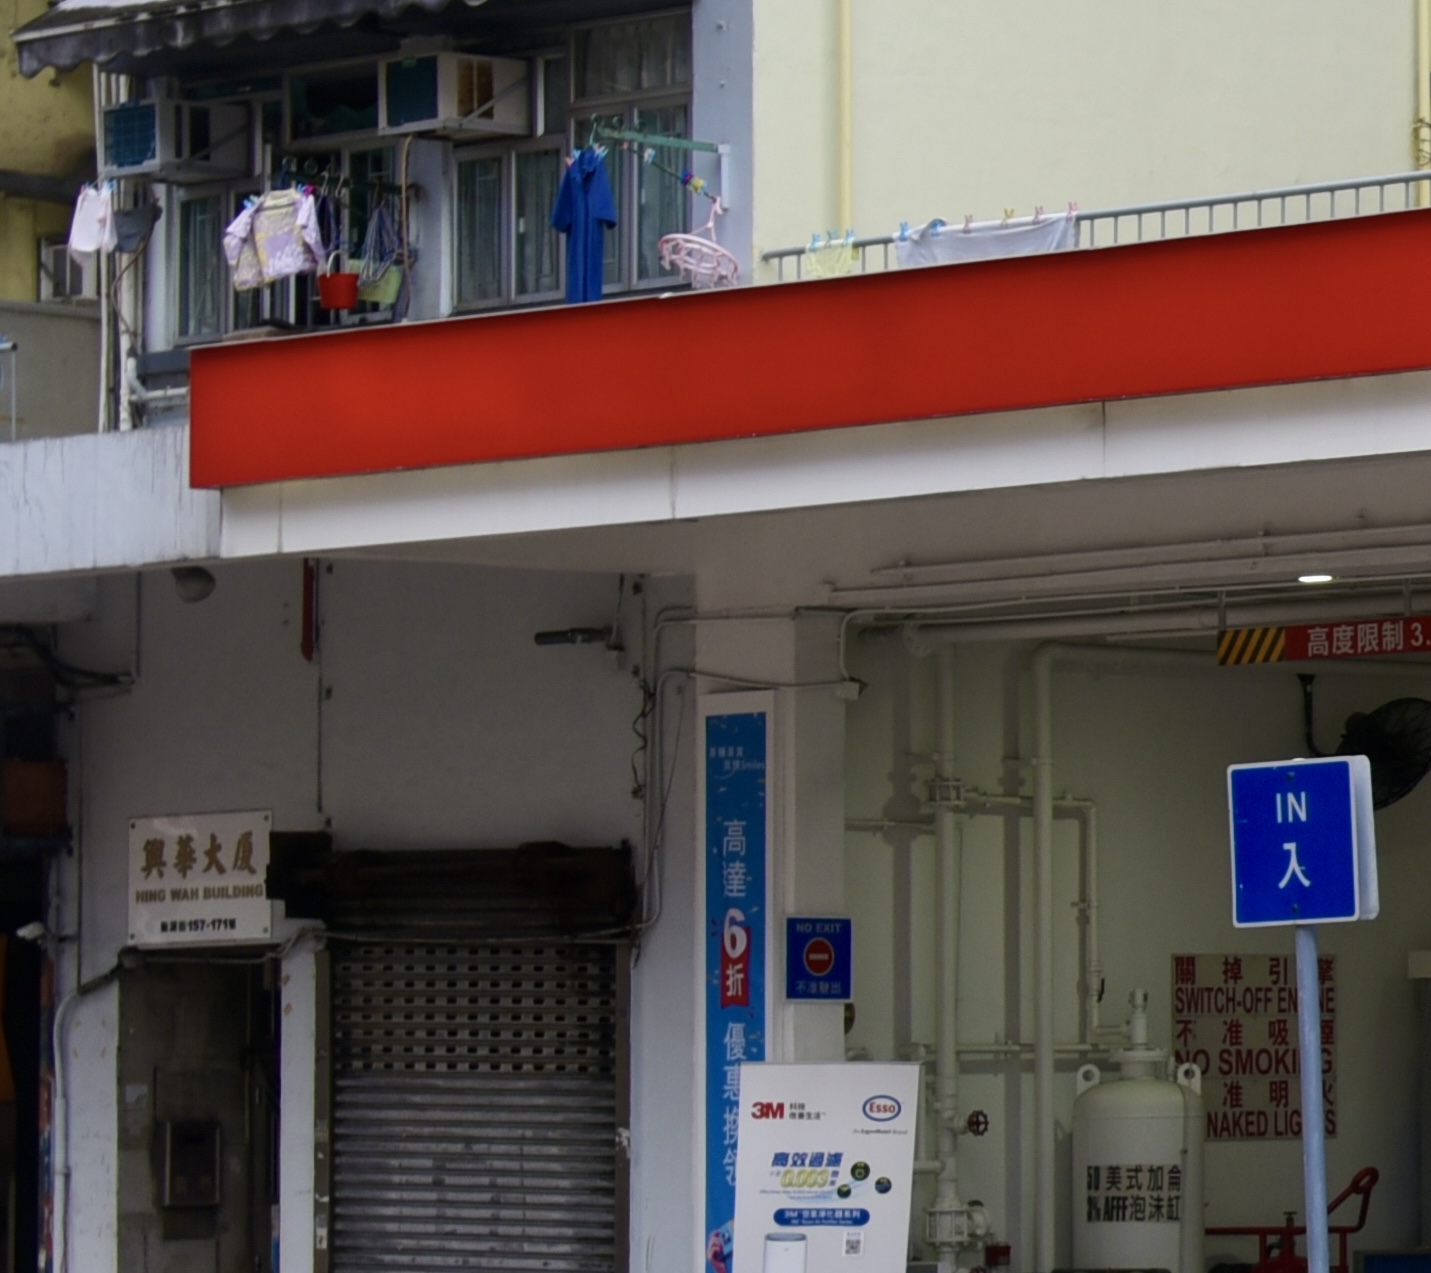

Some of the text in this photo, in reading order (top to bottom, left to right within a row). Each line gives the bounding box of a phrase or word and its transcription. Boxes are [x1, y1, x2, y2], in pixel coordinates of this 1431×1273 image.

[1307, 621, 1405, 658] 高度限制
[1276, 792, 1308, 824] IN
[1278, 841, 1312, 890] 入
[135, 883, 264, 904] HING WAH BUILDING
[796, 922, 842, 934] NO EXIT
[1174, 956, 1335, 986] 關掉引擎
[1174, 987, 1336, 1015] SWITCH-OFF ENNE
[1217, 1048, 1334, 1076] SMOKIG
[751, 1101, 785, 1120] 3M
[868, 1102, 896, 1114] Esso
[1206, 1109, 1336, 1139] NAKED LIGS
